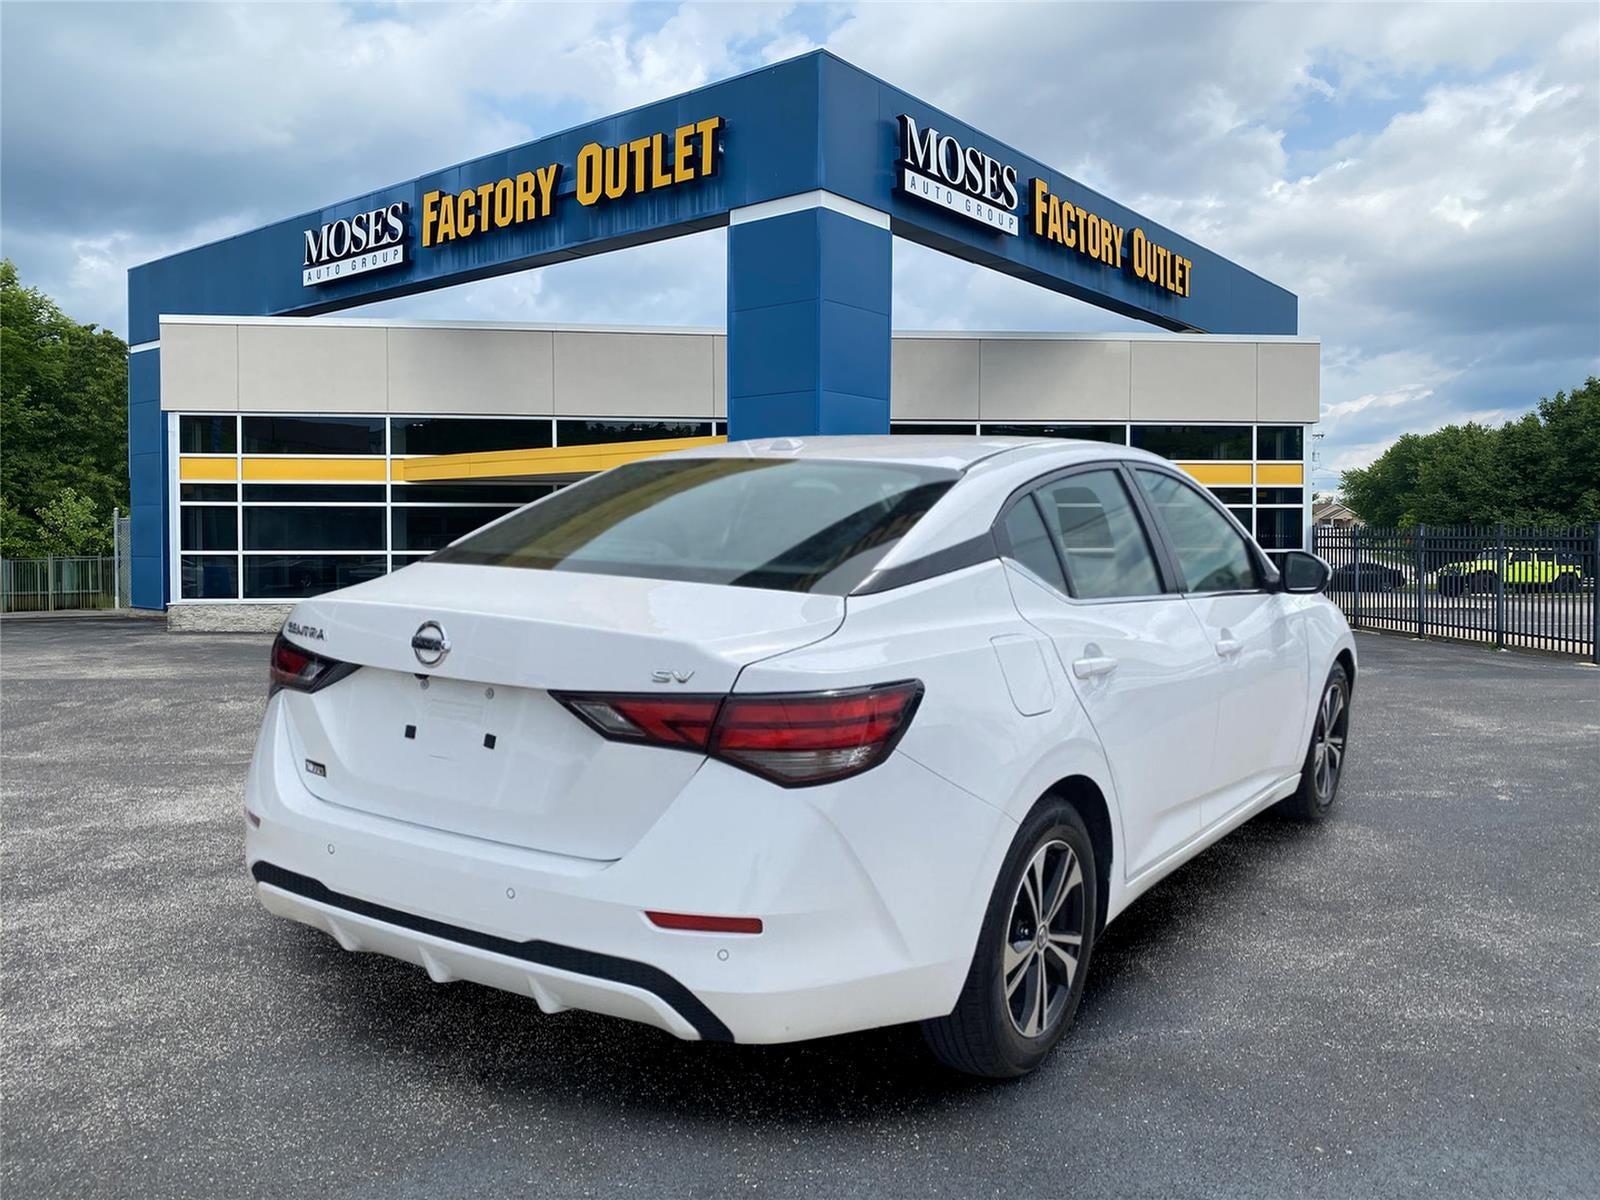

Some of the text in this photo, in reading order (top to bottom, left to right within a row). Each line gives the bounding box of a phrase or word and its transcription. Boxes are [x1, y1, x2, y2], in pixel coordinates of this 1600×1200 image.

[421, 115, 721, 248] FACTORY OUTLET
[903, 113, 1019, 211] MOSES
[303, 202, 404, 266] MOSES
[910, 175, 1015, 230] AUTO GROUP
[306, 249, 400, 283] AUTO GROUP
[1034, 177, 1192, 298] FACTORY OUTLET
[650, 669, 696, 684] SV
